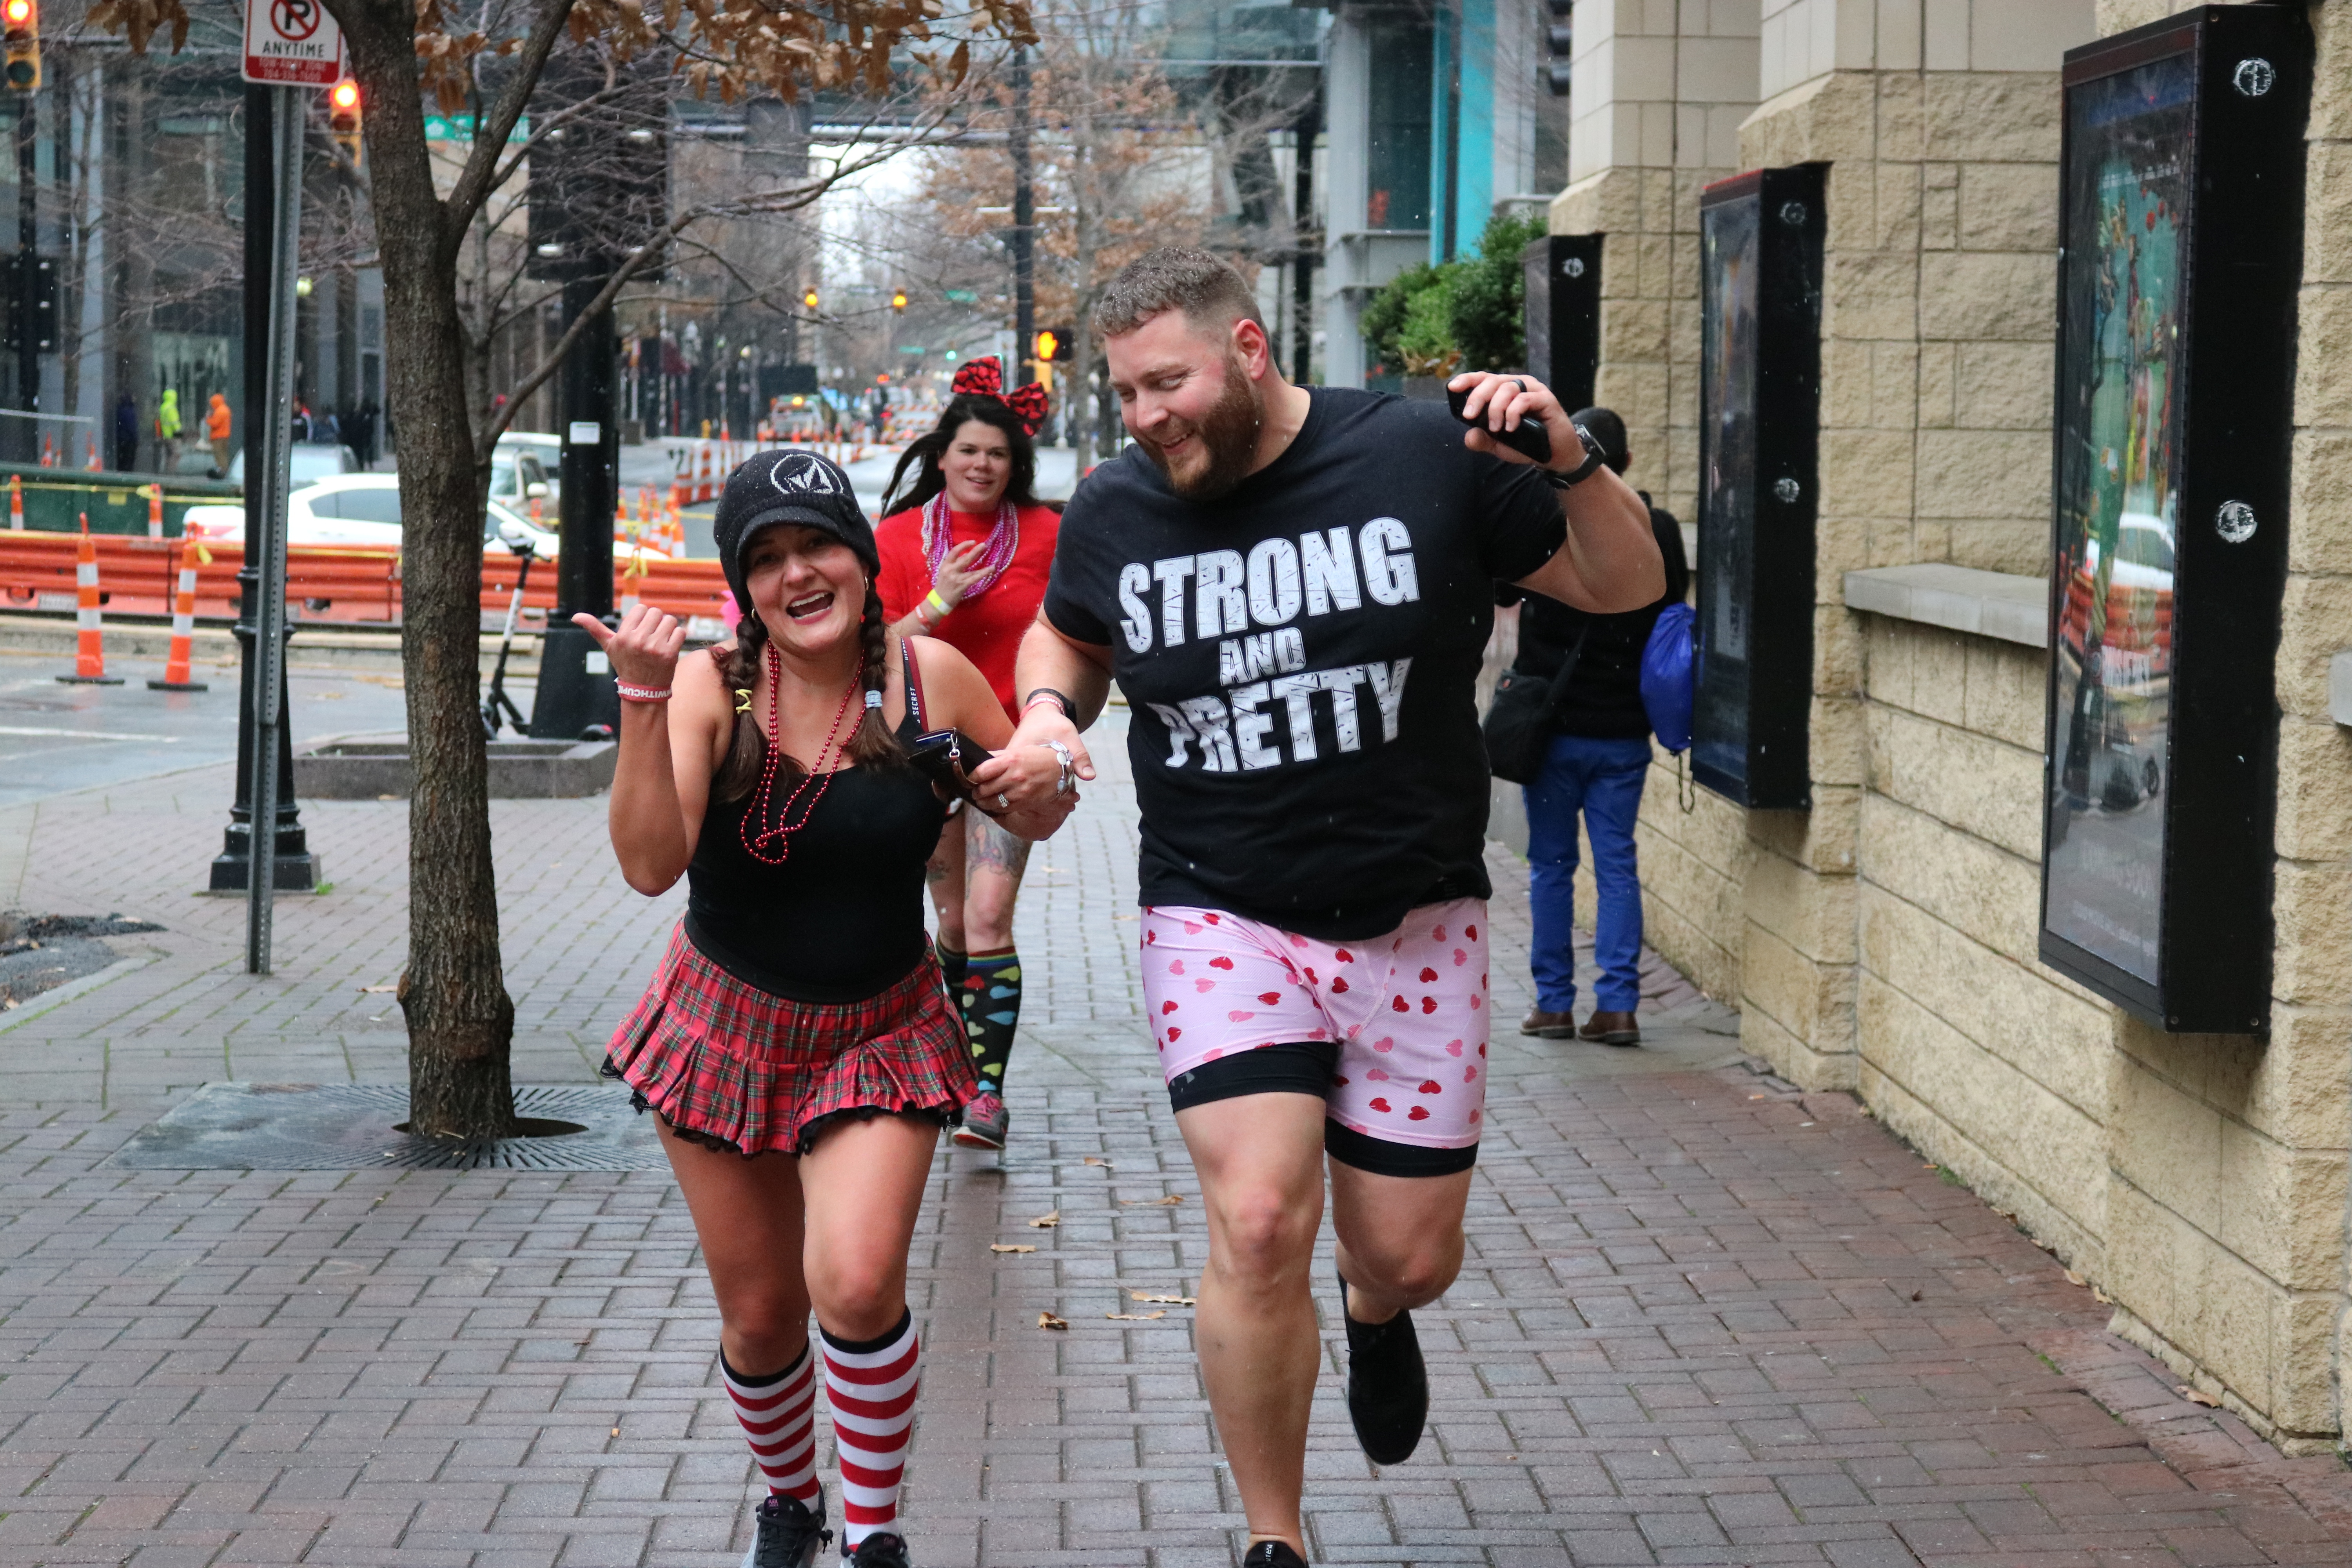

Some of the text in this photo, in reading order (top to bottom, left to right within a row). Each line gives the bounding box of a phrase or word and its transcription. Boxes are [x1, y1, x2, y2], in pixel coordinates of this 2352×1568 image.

[263, 41, 324, 58] ANYTIME
[1119, 517, 1420, 653] STRONG
[1220, 627, 1306, 686] AND
[1145, 657, 1413, 772] PRETTY
